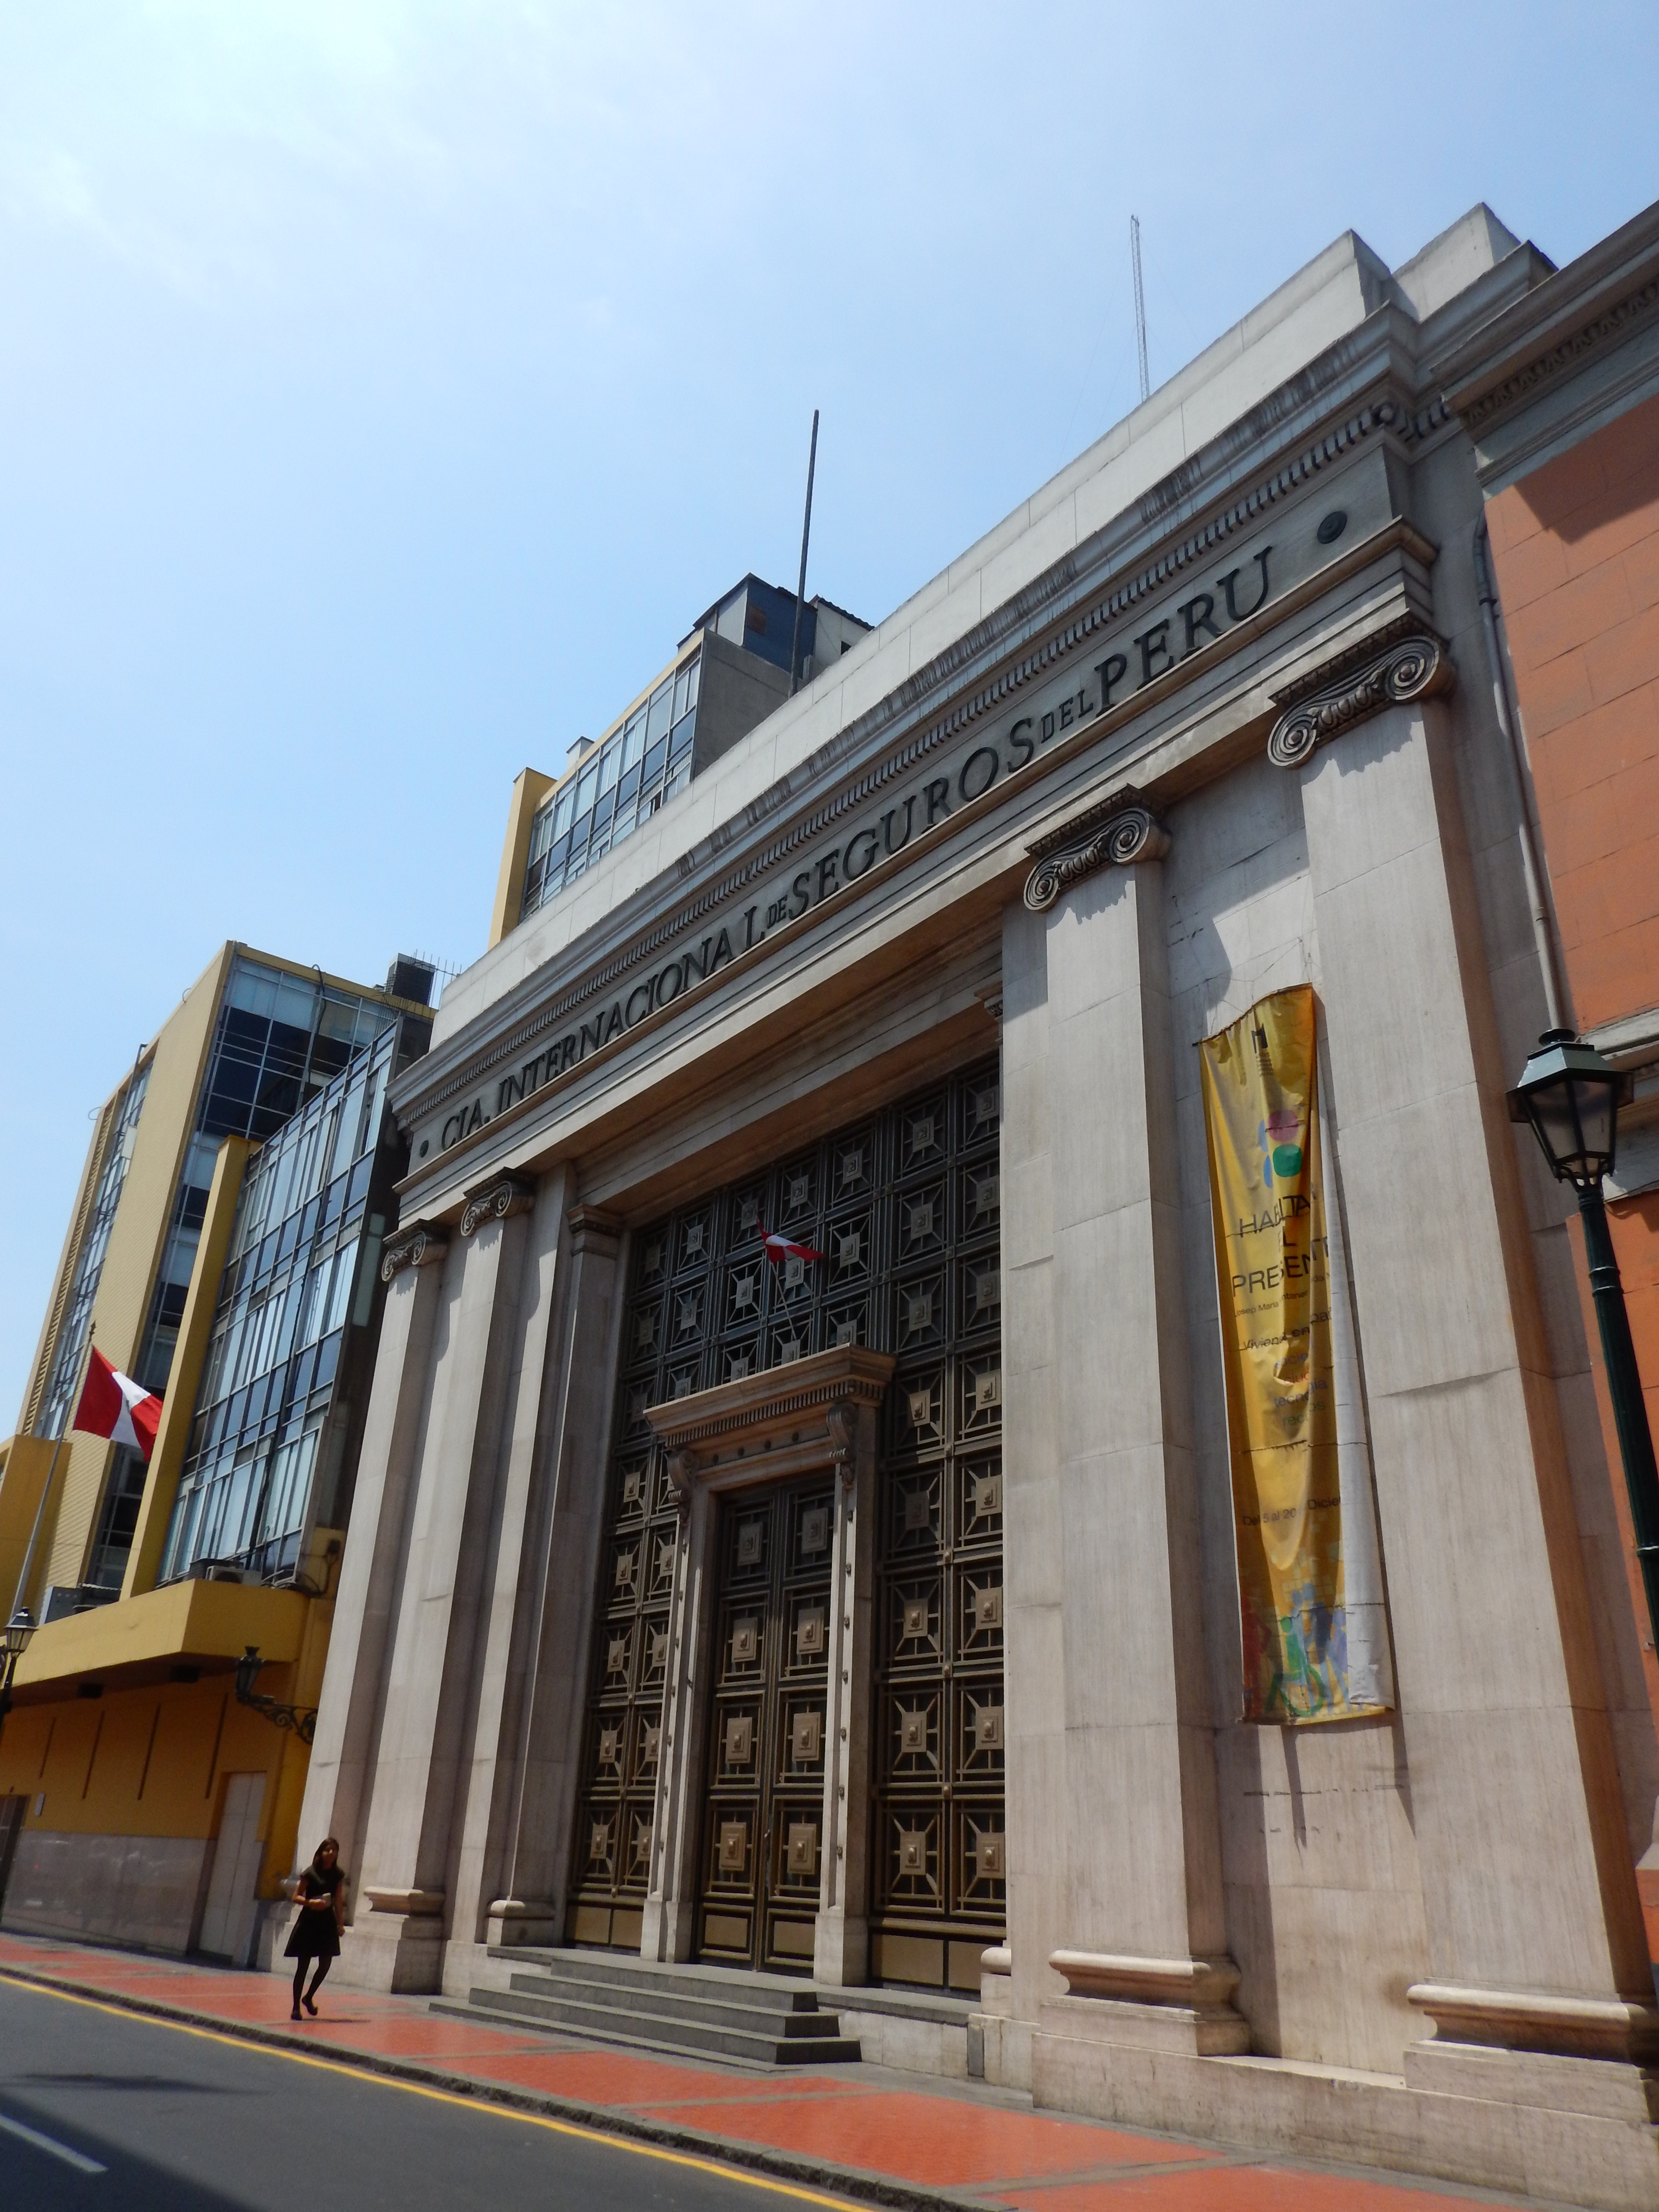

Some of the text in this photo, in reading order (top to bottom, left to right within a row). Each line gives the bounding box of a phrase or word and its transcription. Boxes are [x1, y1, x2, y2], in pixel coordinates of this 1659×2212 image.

[441, 545, 1273, 1151] CIA. INTERNACIONAL DE SEGUROS DEL PERU
[1239, 1182, 1317, 1238] HABITA
